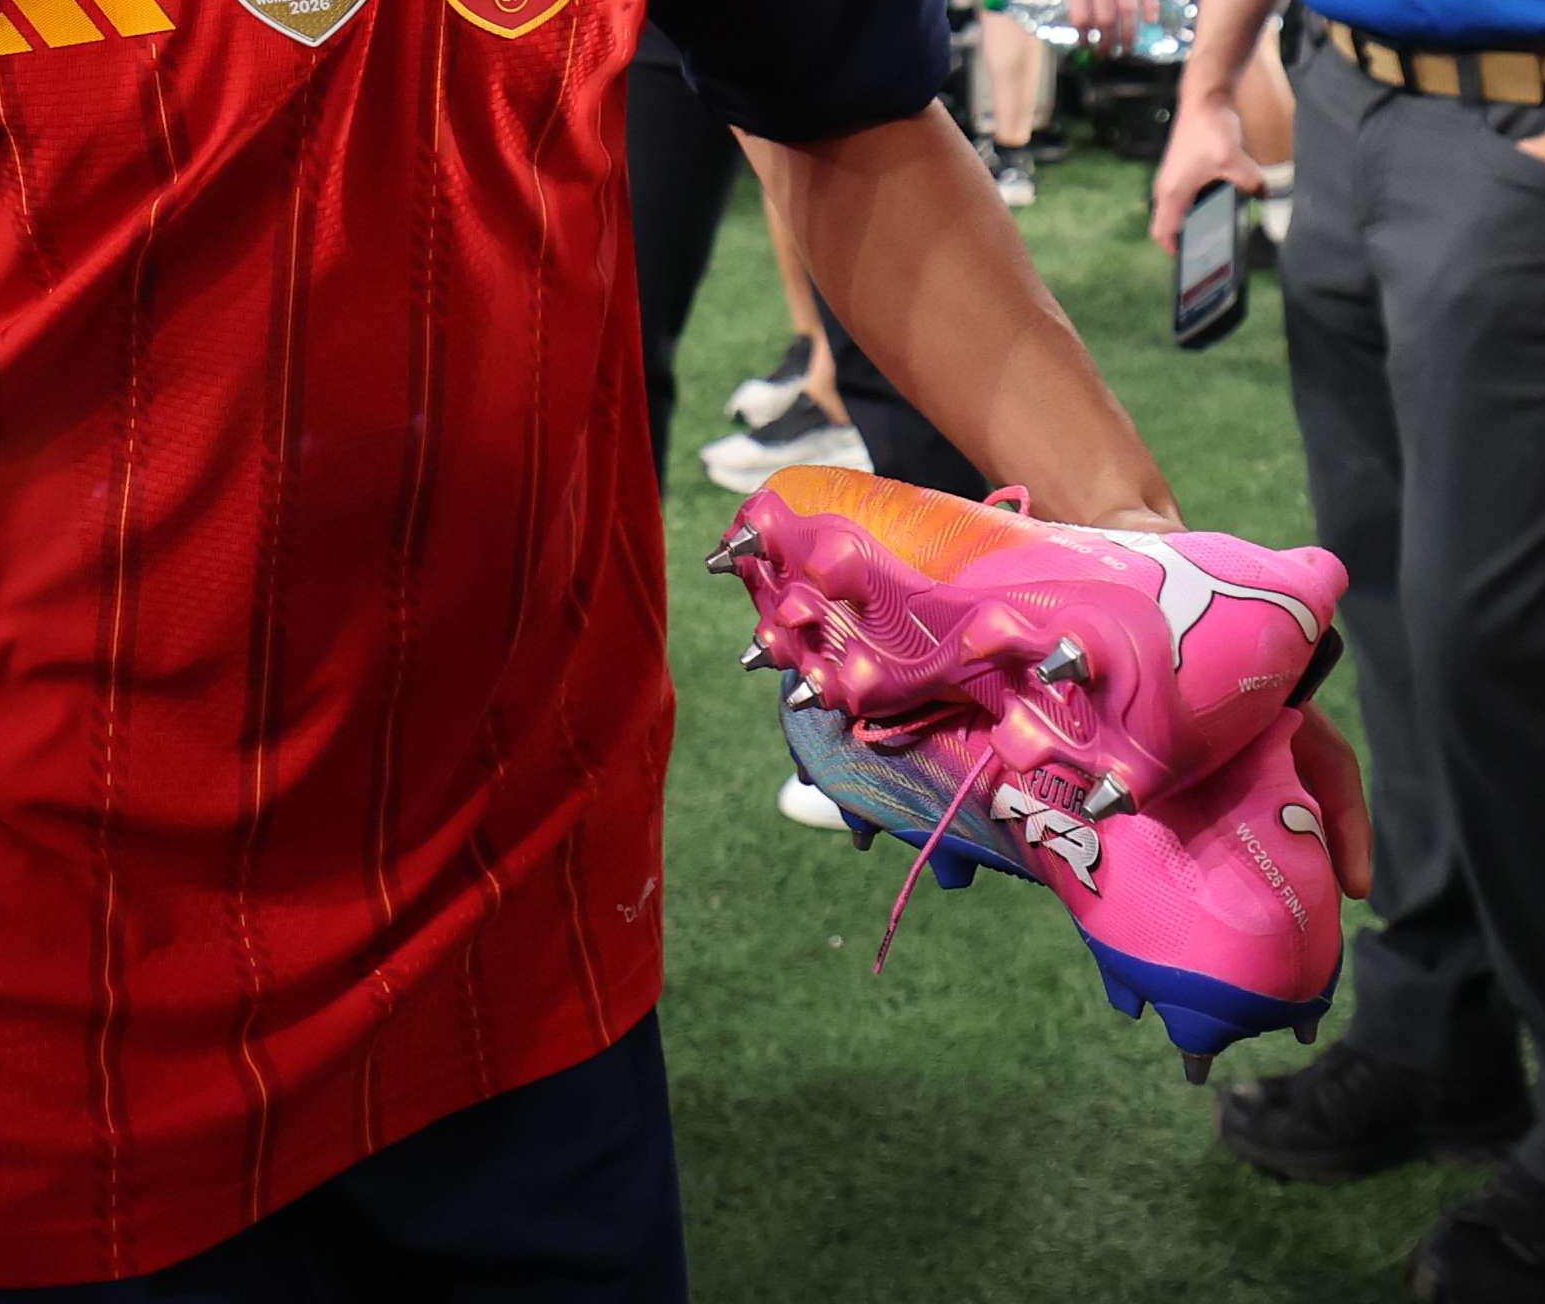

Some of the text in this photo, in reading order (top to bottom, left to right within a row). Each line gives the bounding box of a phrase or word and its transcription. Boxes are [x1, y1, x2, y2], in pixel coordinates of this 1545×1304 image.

[1028, 767, 1087, 814] FUTUR
[1236, 822, 1309, 932] WC2026 FINAL
